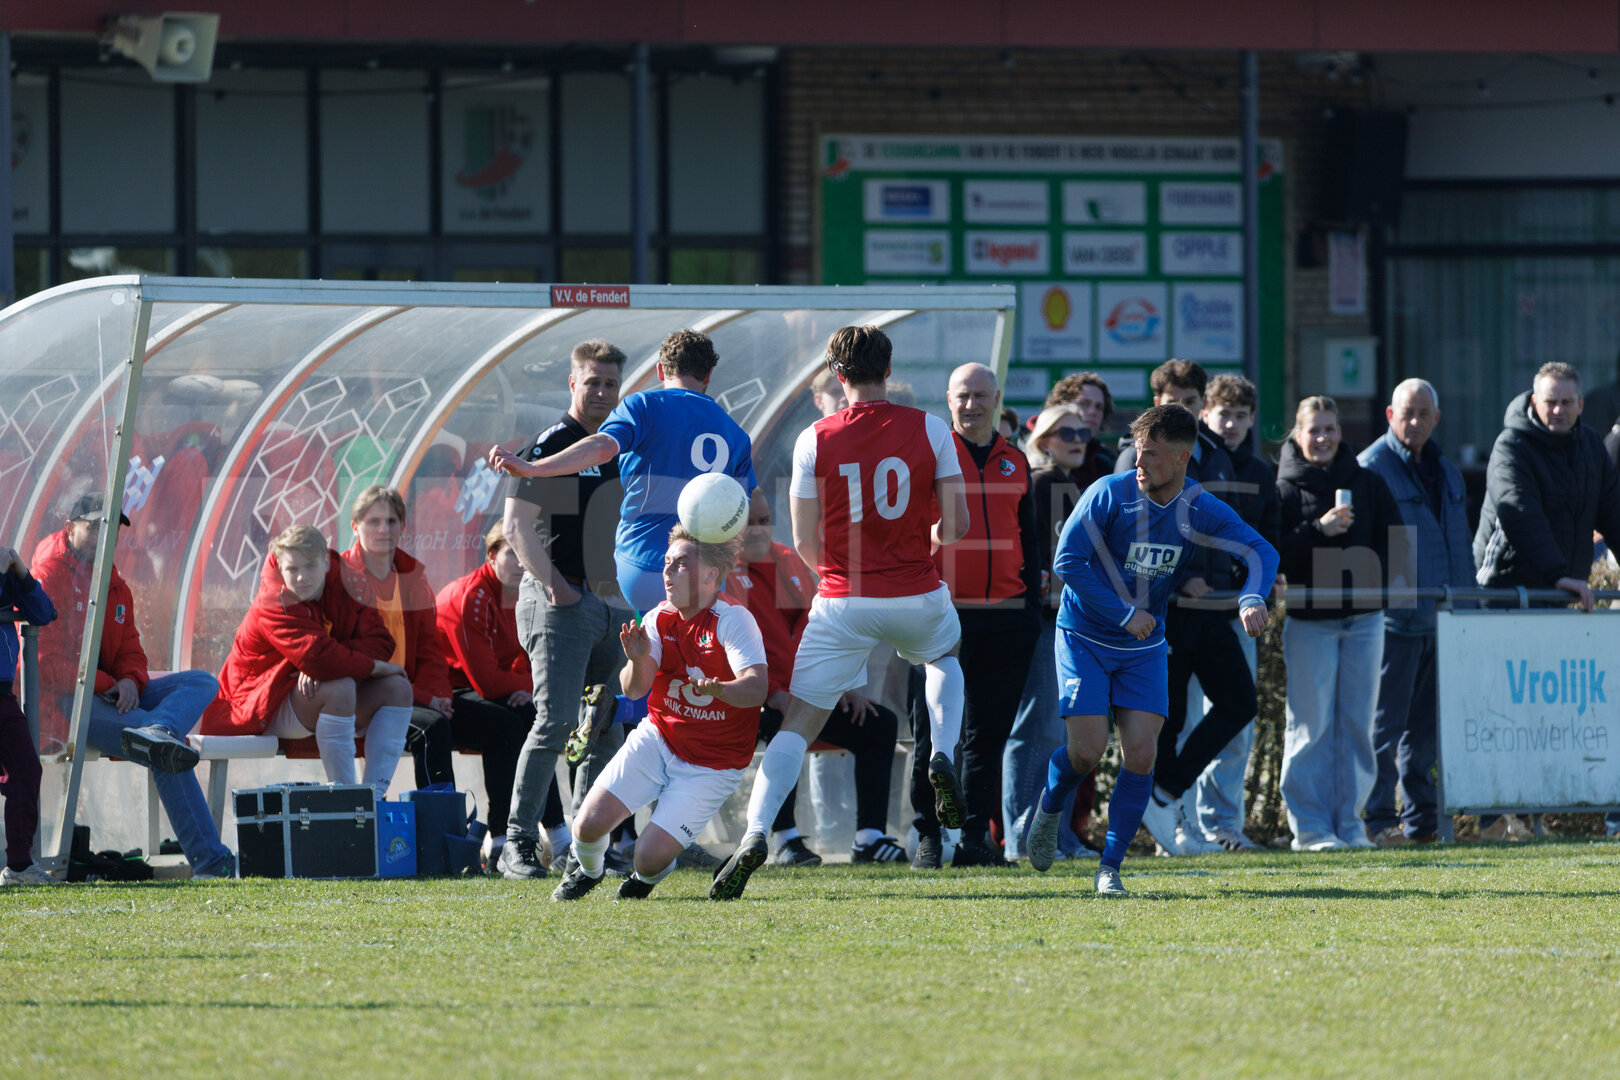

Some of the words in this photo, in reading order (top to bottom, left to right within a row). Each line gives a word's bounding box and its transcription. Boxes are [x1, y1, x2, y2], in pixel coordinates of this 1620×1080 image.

[554, 289, 574, 303] V.V.
[575, 289, 588, 303] de
[590, 289, 628, 304] Fendert
[690, 432, 730, 474] 9
[838, 456, 911, 524] 10
[1123, 504, 1144, 514] hummel
[1064, 677, 1082, 709] 7
[1505, 658, 1608, 717] Vrolijk
[663, 697, 682, 716] RIJK
[683, 705, 726, 721] ZWAAN
[1463, 716, 1609, 753] Betonwerken
[680, 823, 694, 839] JAKO
